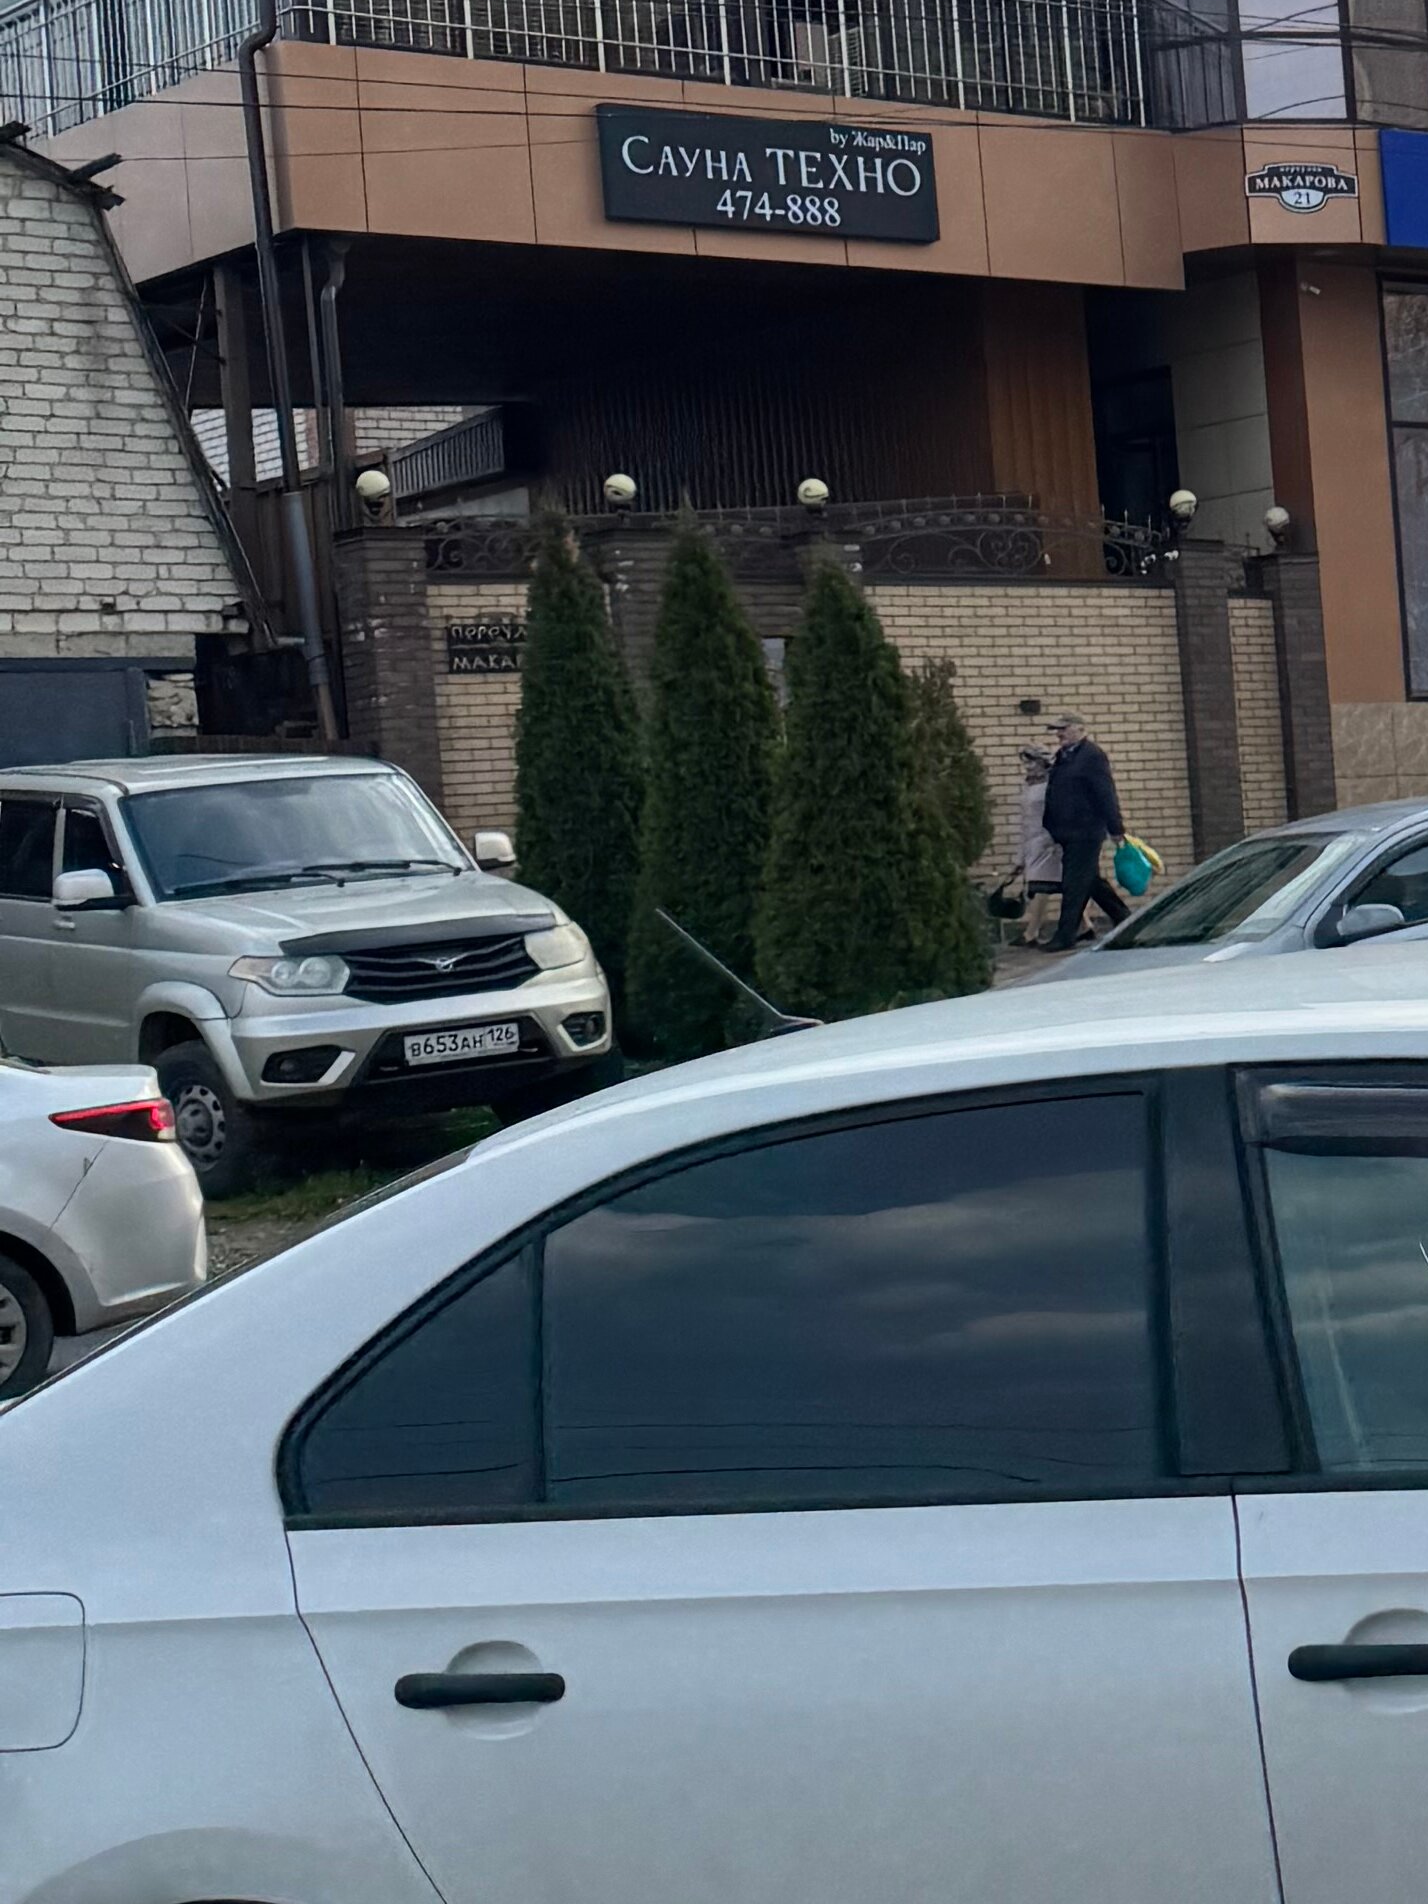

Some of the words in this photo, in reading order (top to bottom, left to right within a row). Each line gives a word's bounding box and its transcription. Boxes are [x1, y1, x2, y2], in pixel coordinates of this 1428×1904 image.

[829, 128, 848, 149] by
[765, 148, 921, 196] ТЕХНО
[1255, 175, 1348, 190] МАКАРОВА
[1294, 191, 1311, 205] 21
[716, 189, 842, 227] 474-888
[487, 1027, 516, 1042] 126
